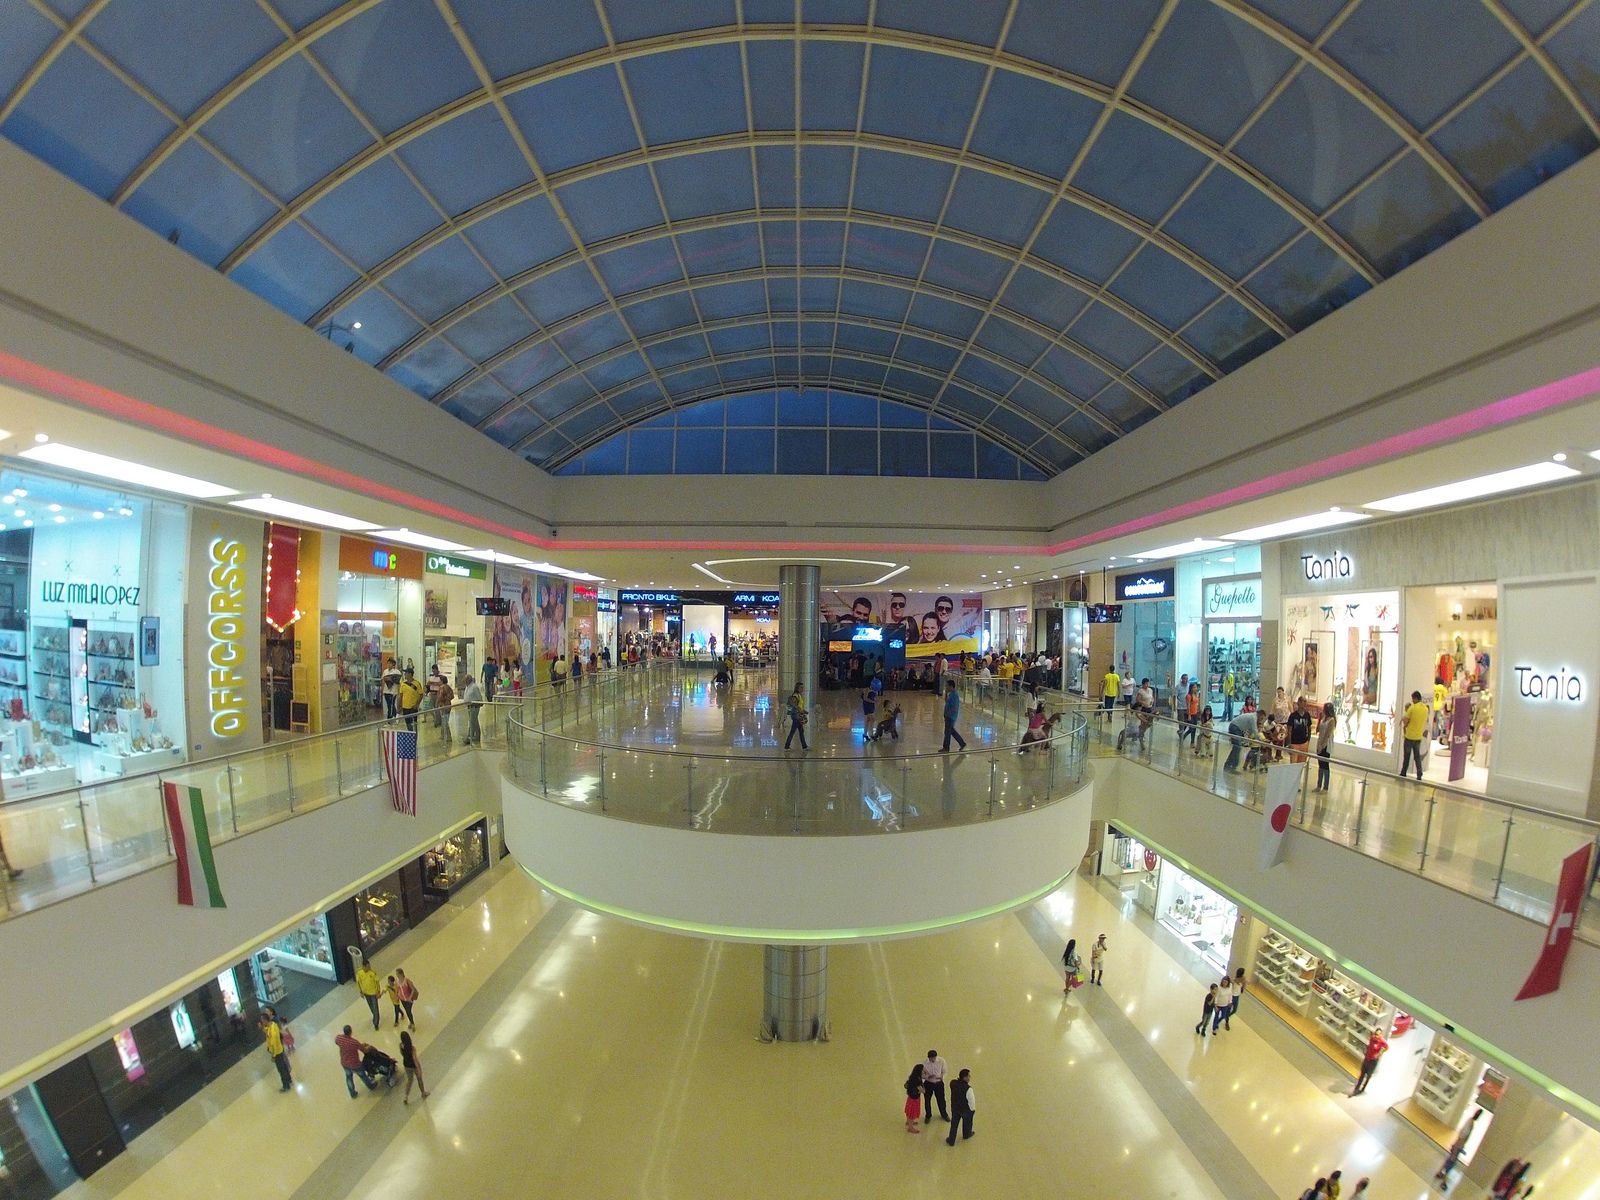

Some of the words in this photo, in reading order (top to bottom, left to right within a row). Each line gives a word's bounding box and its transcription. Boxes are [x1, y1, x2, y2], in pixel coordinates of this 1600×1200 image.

[1300, 550, 1350, 580] Tania
[43, 581, 64, 602] LUZ
[100, 585, 140, 606] LOPEZ
[622, 593, 655, 601] PRONTO
[208, 537, 247, 738] OFFCORSS
[1514, 668, 1581, 701] Tania
